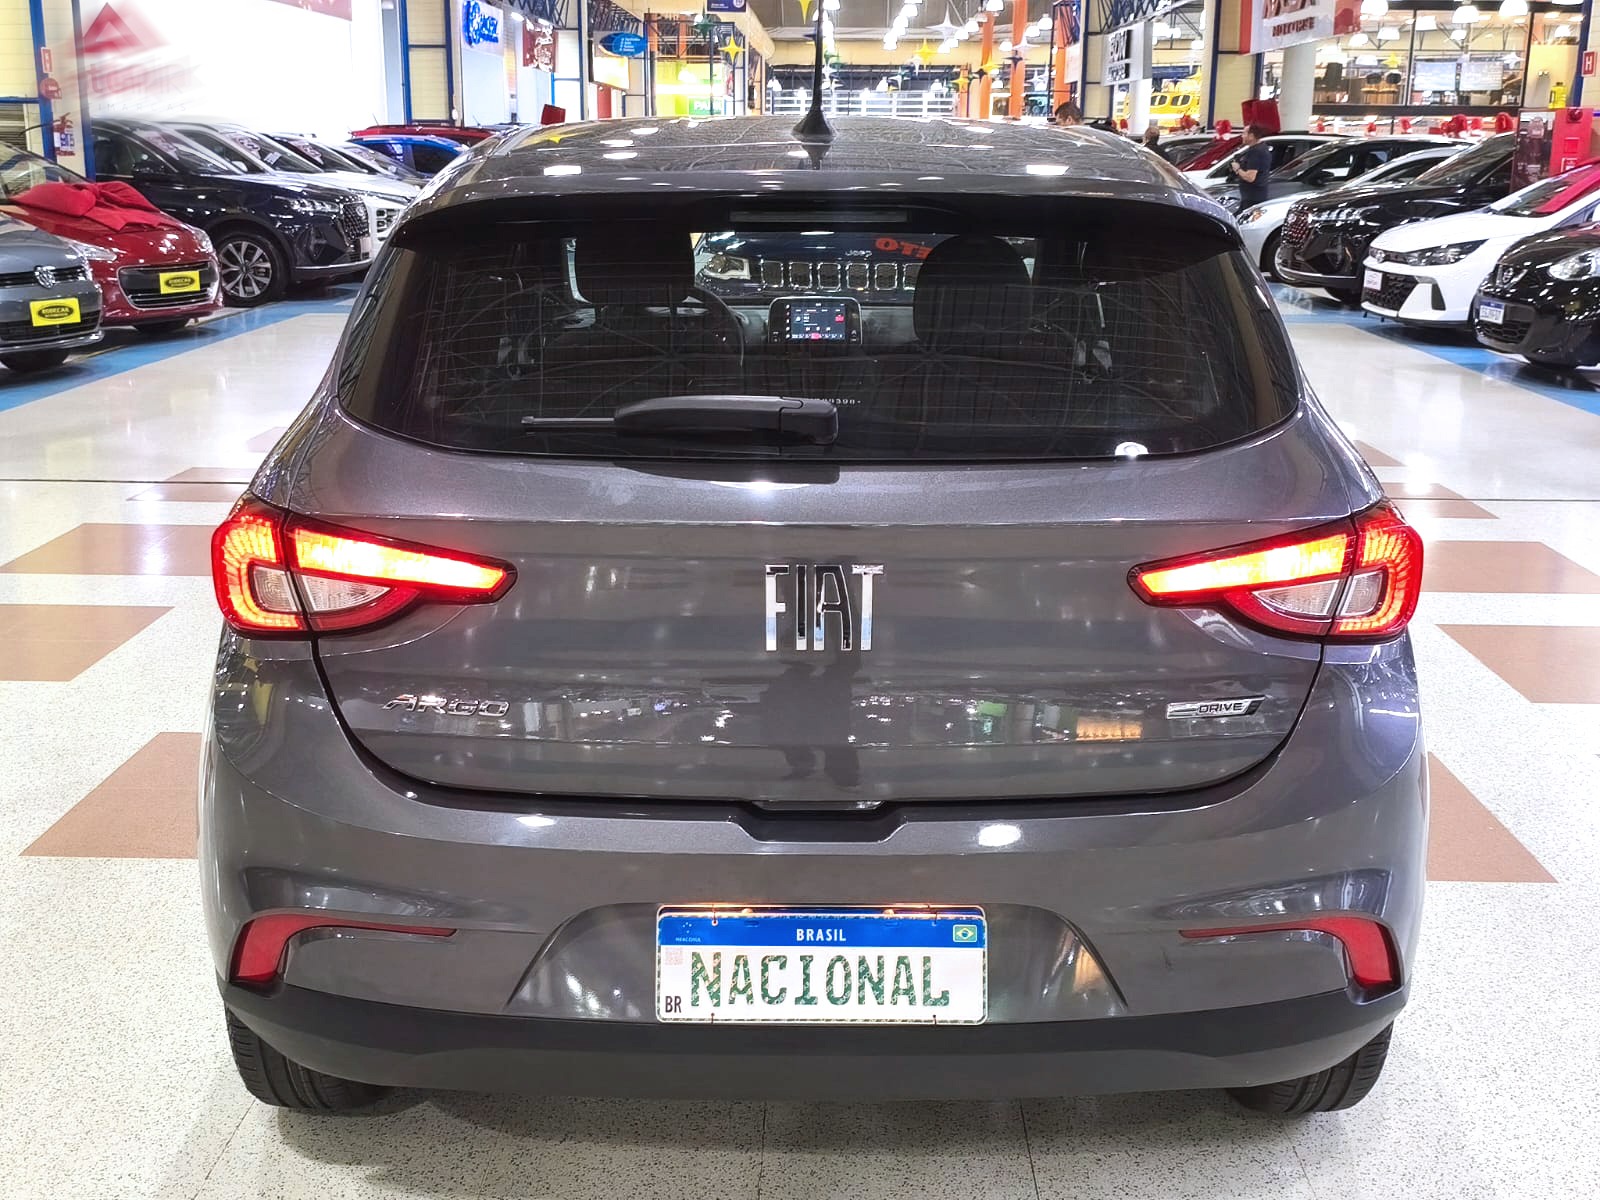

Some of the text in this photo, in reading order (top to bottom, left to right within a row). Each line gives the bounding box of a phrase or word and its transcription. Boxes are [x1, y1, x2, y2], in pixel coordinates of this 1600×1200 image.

[1585, 55, 1593, 72] H
[765, 564, 884, 651] FIAT
[382, 693, 510, 717] ARGO
[1198, 702, 1244, 714] DRIVE
[796, 928, 848, 942] BRASIL
[690, 951, 950, 1007] NACIONAL
[664, 995, 682, 1014] BR
